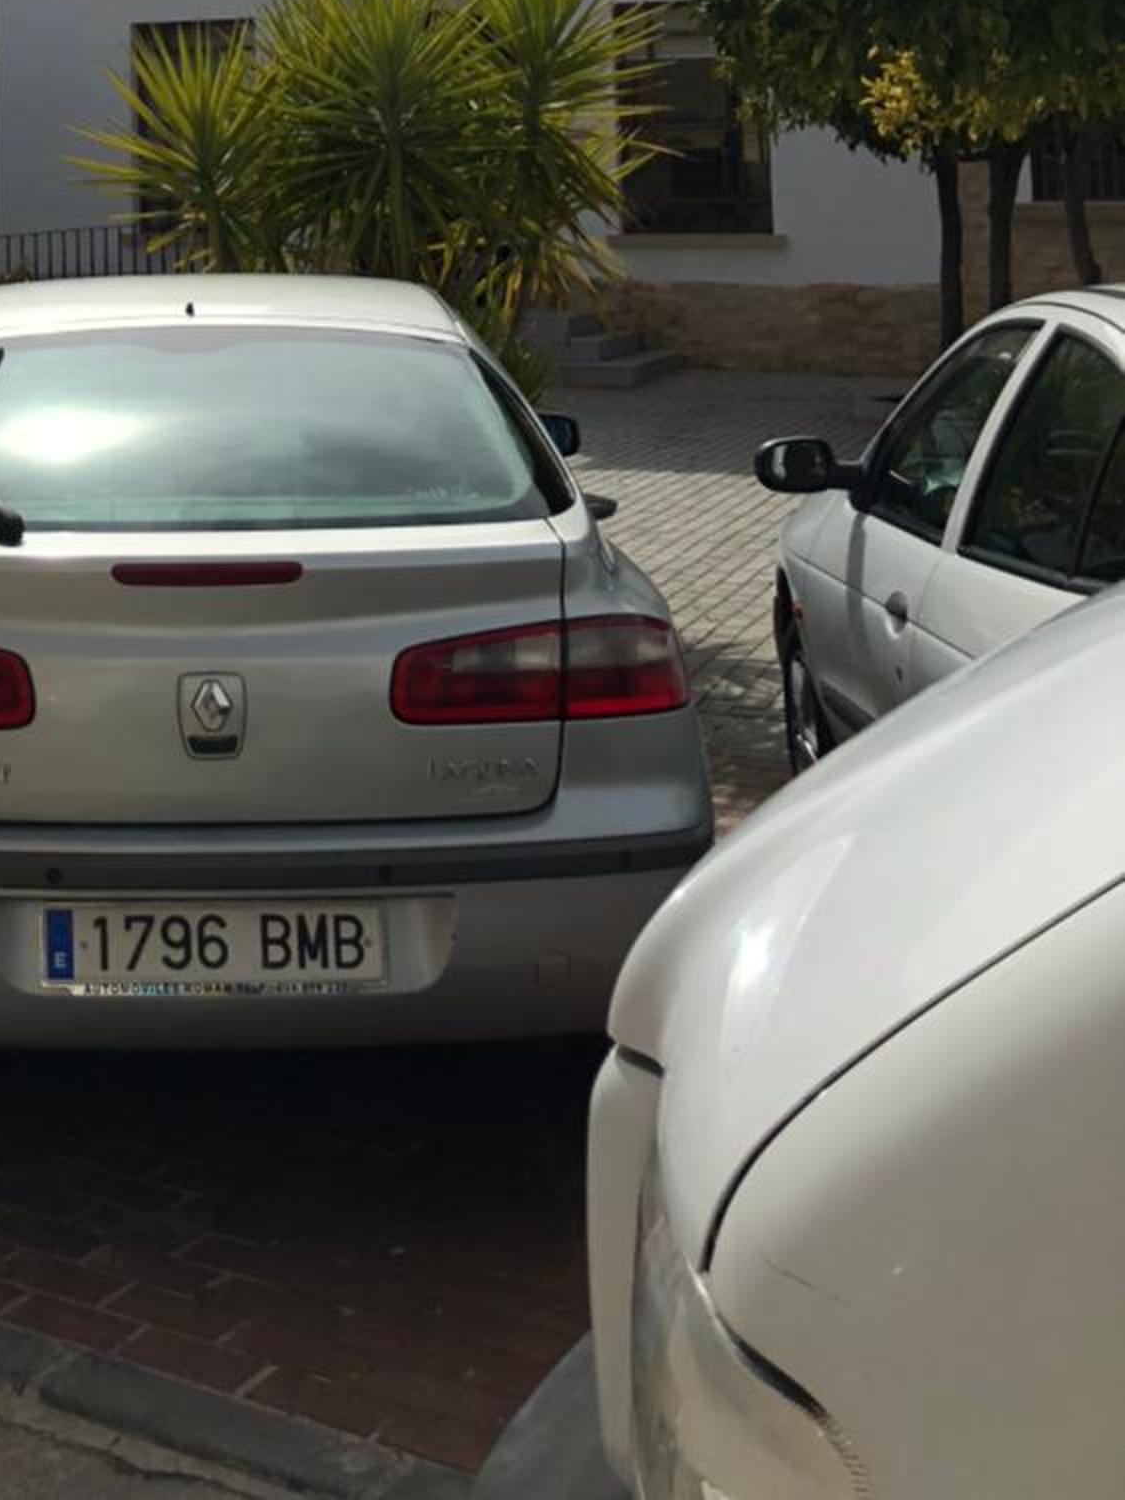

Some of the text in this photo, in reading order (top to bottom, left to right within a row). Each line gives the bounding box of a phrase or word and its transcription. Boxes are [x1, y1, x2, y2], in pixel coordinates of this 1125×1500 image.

[53, 951, 68, 969] E
[93, 913, 365, 971] 1796 BMB
